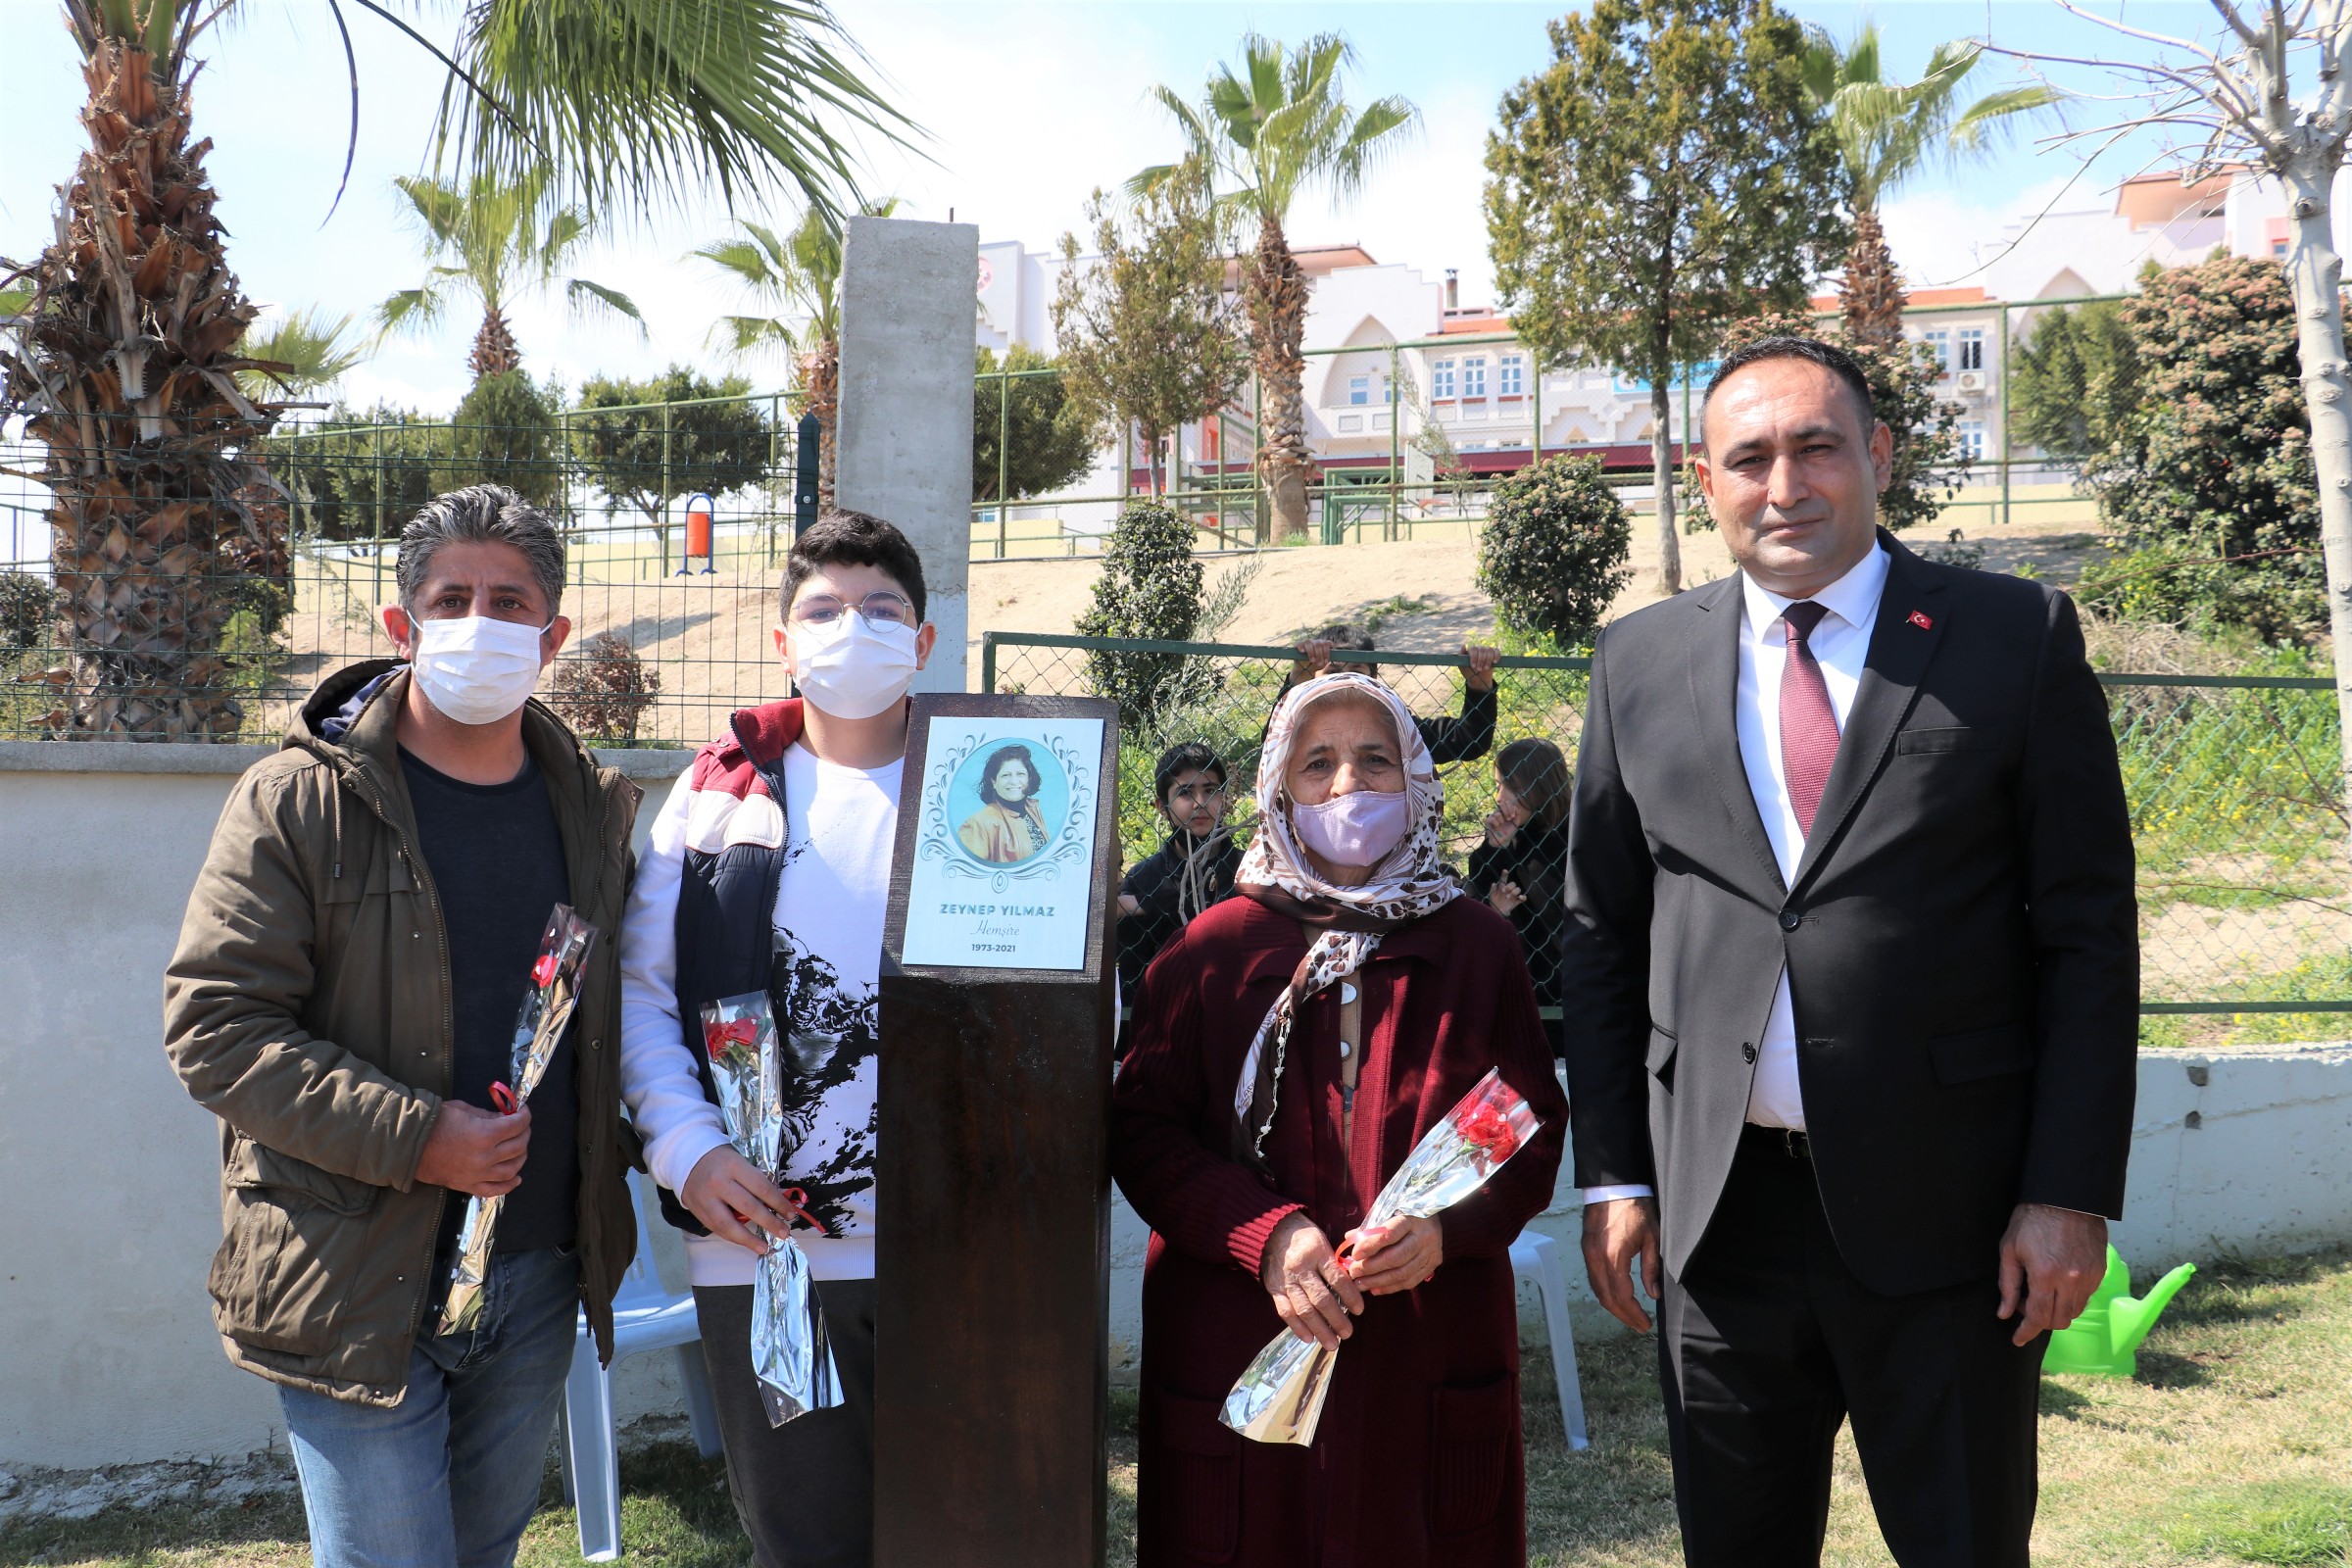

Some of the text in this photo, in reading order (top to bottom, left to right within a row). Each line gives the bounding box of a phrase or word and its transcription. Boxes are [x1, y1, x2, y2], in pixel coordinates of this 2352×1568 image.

[939, 904, 1055, 917] ZEYNEP YILMAZ
[970, 919, 1020, 937] Hemşire
[971, 944, 1016, 953] 1973-2021
